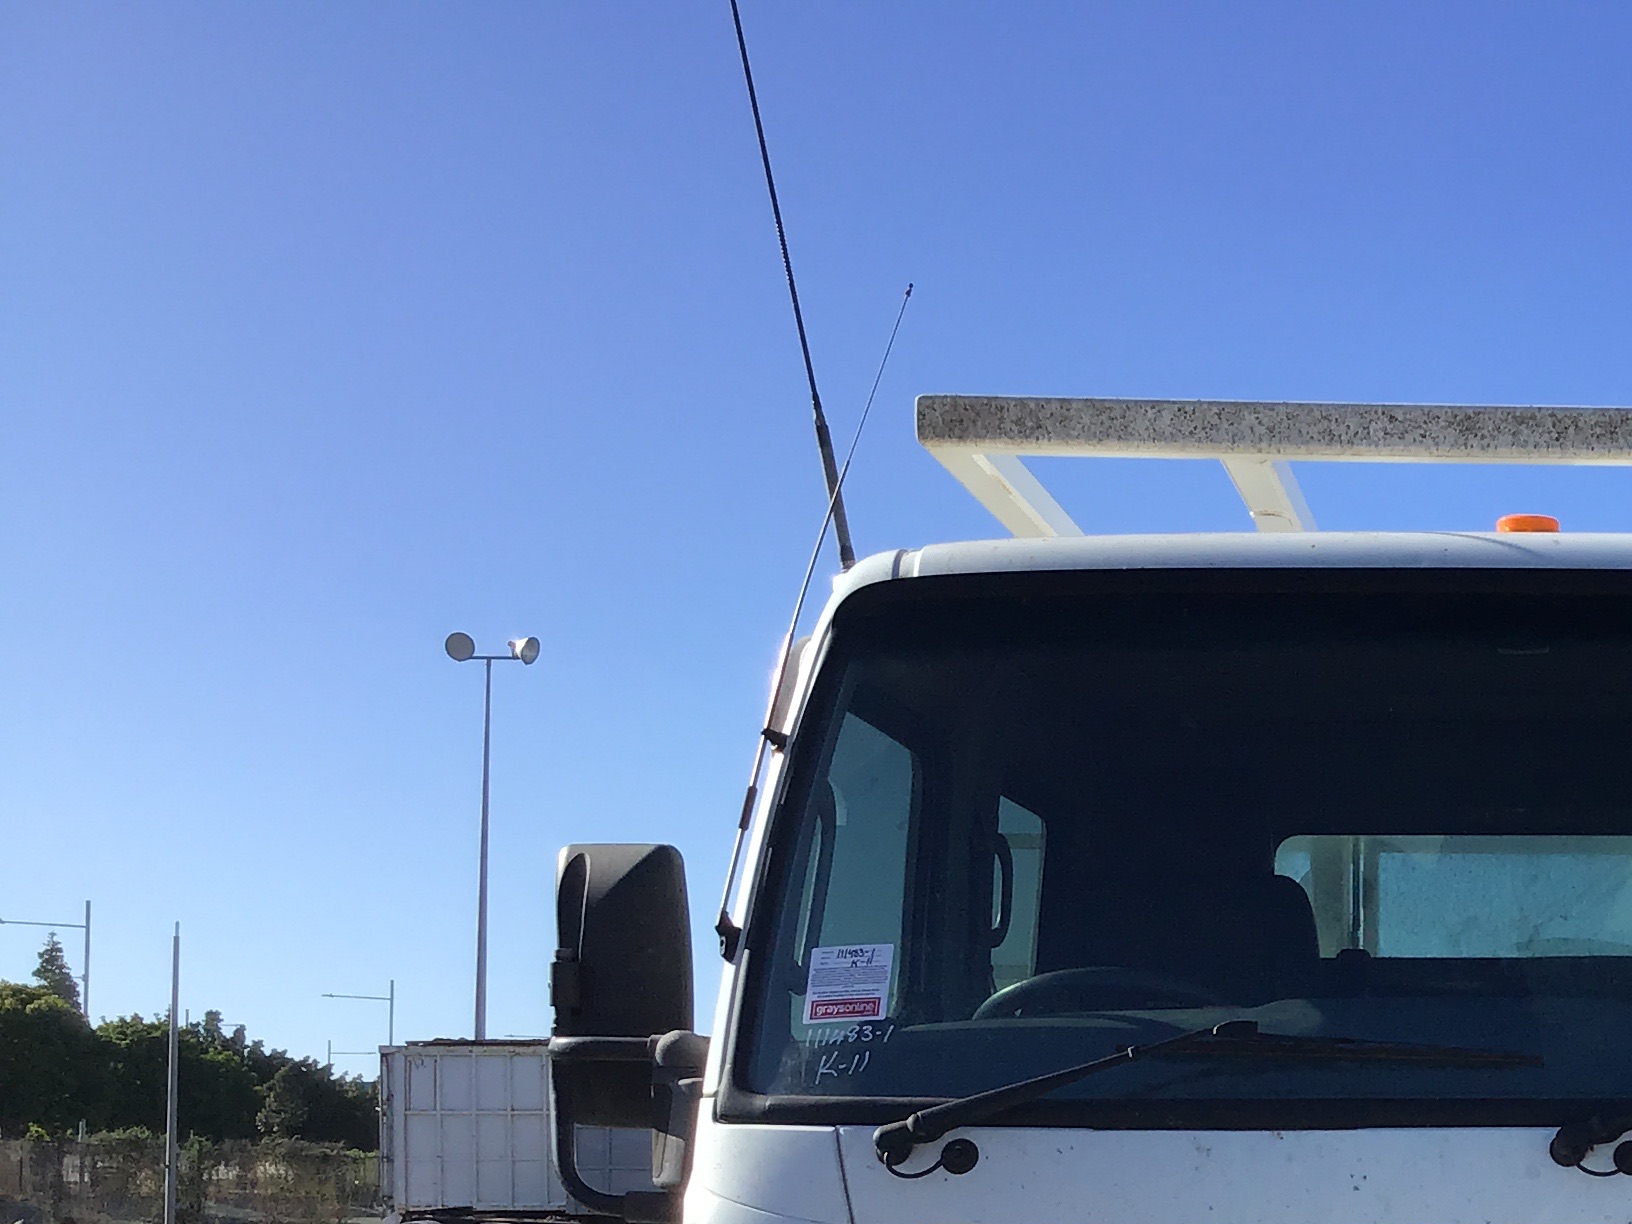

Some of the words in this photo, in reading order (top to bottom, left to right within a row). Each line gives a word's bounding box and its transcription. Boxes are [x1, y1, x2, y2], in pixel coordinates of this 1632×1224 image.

[816, 1002, 875, 1016] graysonline
[805, 1025, 894, 1049] 111483-1
[815, 1050, 870, 1085] K-11
